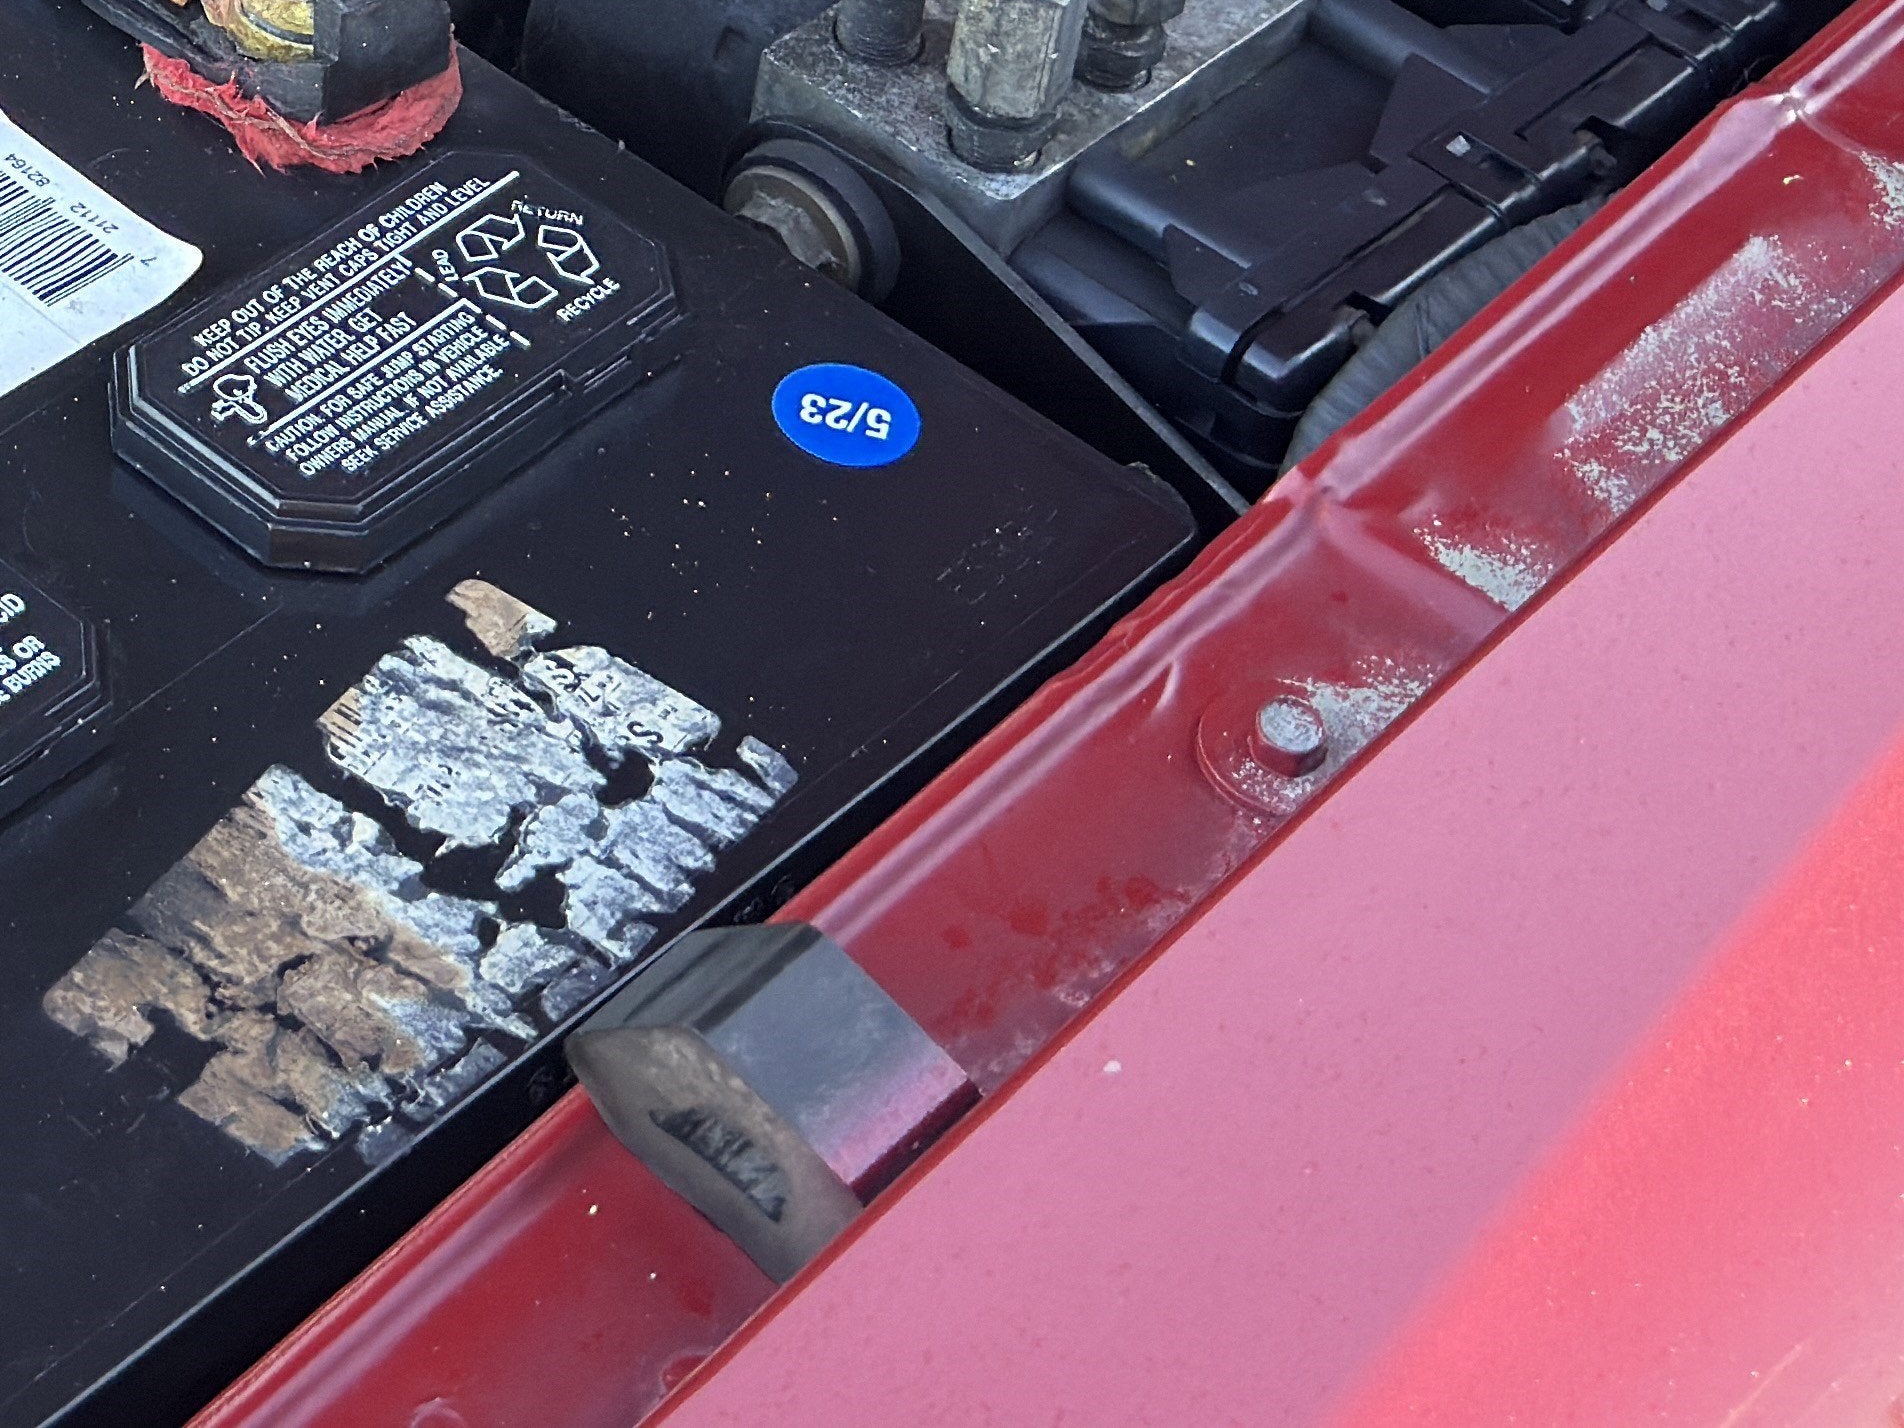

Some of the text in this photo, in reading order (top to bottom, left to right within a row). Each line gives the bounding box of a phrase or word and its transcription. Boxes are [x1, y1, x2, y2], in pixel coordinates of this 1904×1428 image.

[3, 153, 50, 187] 82164
[69, 201, 119, 233] 21112
[510, 194, 583, 233] RETURN
[139, 256, 156, 266] 7
[181, 356, 209, 376] DO
[205, 336, 239, 361] NOT
[264, 295, 301, 324] KEEP
[300, 272, 340, 299] VENT
[338, 248, 378, 276] CAPS
[372, 220, 417, 251] TIGHT
[415, 202, 448, 225] AND
[444, 177, 490, 206] LEVEL
[192, 181, 447, 346] KEEP OUT OF THE REACH OF CHILDREN
[431, 248, 459, 281] LEAD
[243, 261, 410, 374] FLUSH EYES IMMEDIATELY
[556, 277, 619, 321] RECYCLE
[262, 357, 308, 387] WITH
[347, 306, 382, 332] GET
[284, 311, 416, 402] MEDICAL HELP FAST
[799, 393, 893, 440] 5/23
[12, 635, 45, 658] OR
[1, 651, 60, 693] BURNS
